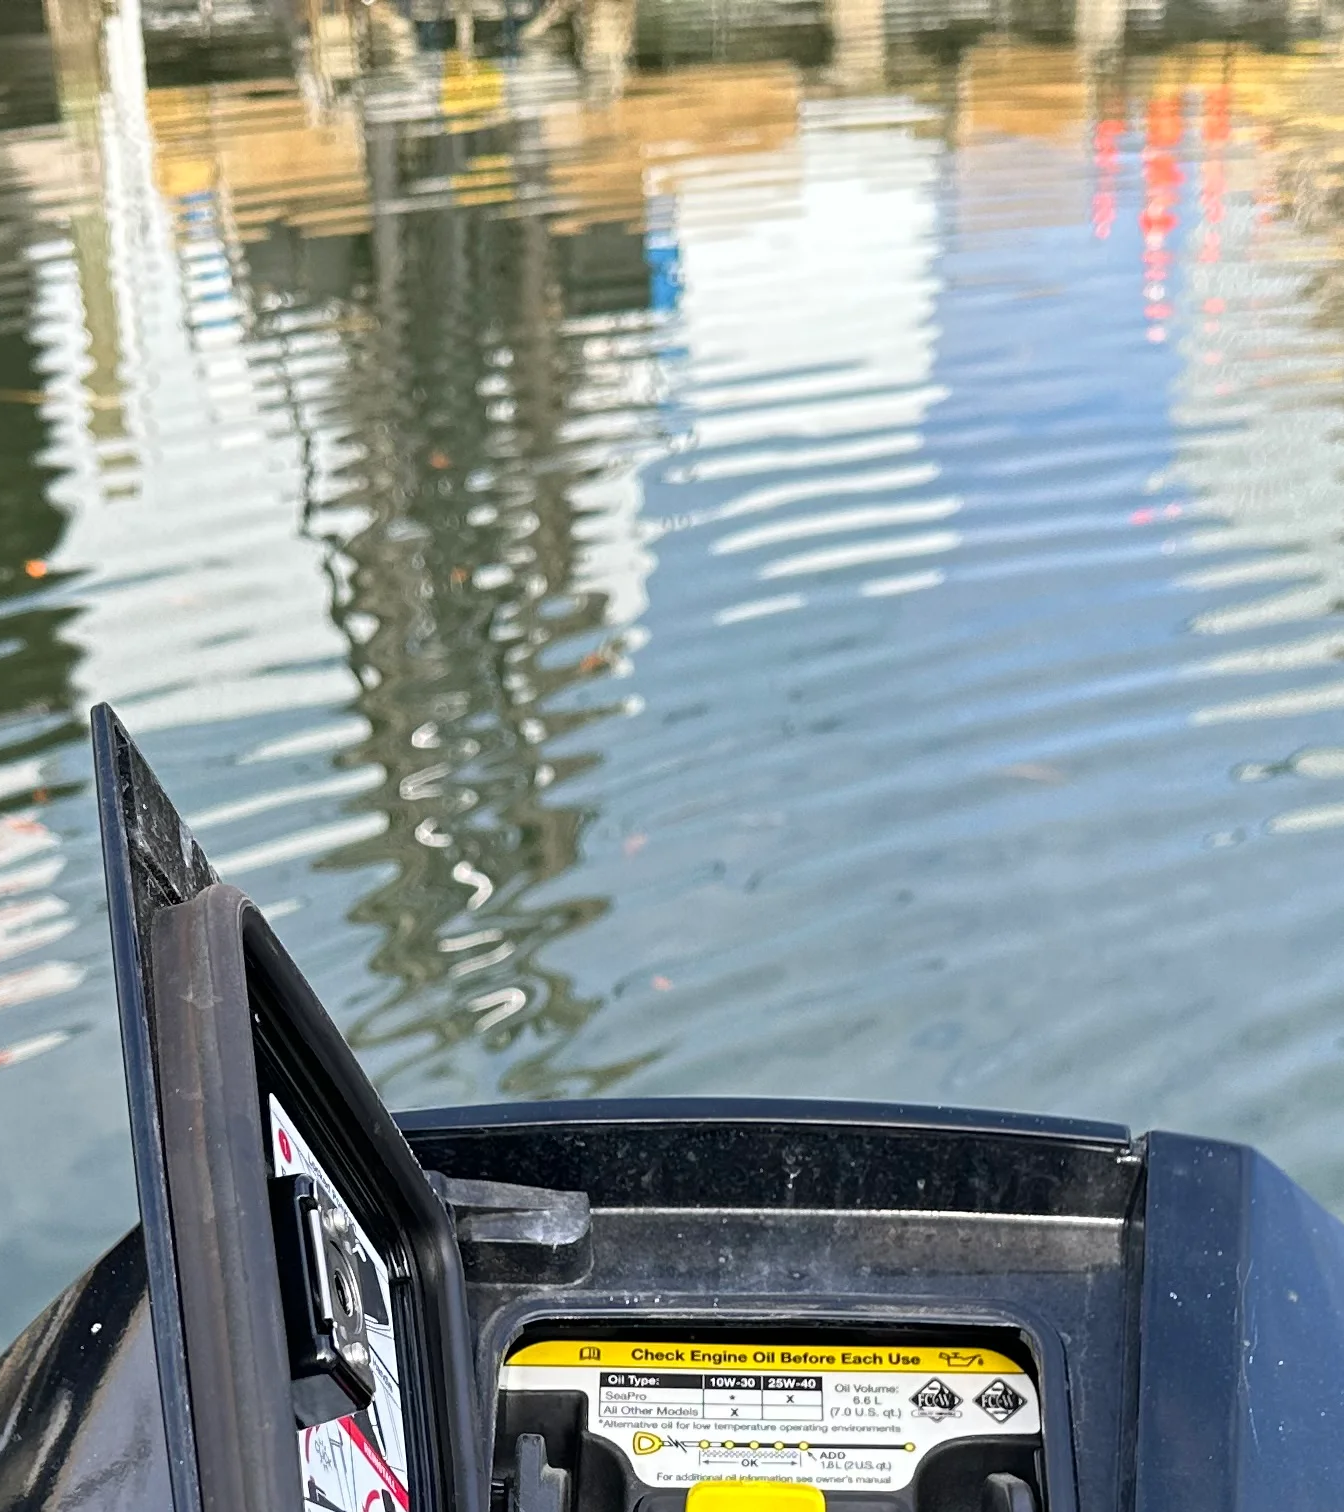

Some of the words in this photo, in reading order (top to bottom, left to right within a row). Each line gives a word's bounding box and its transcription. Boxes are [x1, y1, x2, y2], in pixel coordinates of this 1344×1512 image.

[631, 1348, 685, 1362] Check
[690, 1350, 748, 1365] Engine
[752, 1350, 775, 1363] Oil
[780, 1351, 836, 1365] Before
[841, 1353, 883, 1365] Each
[888, 1353, 921, 1366] Use
[607, 1374, 625, 1385] Oil
[627, 1375, 660, 1387] Type:
[709, 1377, 756, 1388] 10W-30
[767, 1378, 817, 1389] 25W-40
[834, 1383, 851, 1393] Oil
[853, 1383, 899, 1393] Volume:
[605, 1391, 647, 1401] SeaPro
[786, 1394, 795, 1404] X
[853, 1395, 871, 1405] 6.6
[874, 1396, 882, 1405] L
[603, 1405, 618, 1415] All
[620, 1405, 653, 1415] Other
[656, 1407, 699, 1416] Models
[730, 1407, 739, 1417] X
[830, 1407, 852, 1418] (7.0
[856, 1407, 880, 1417] U.S.
[882, 1407, 902, 1419] qt.)
[660, 1420, 673, 1429] oil
[676, 1420, 690, 1430] for
[692, 1421, 711, 1430] low
[714, 1422, 777, 1432] temperature
[779, 1424, 828, 1433] operating
[831, 1424, 902, 1433] environments
[741, 1458, 759, 1467] OK
[656, 1472, 673, 1481] For
[675, 1473, 723, 1482] additional
